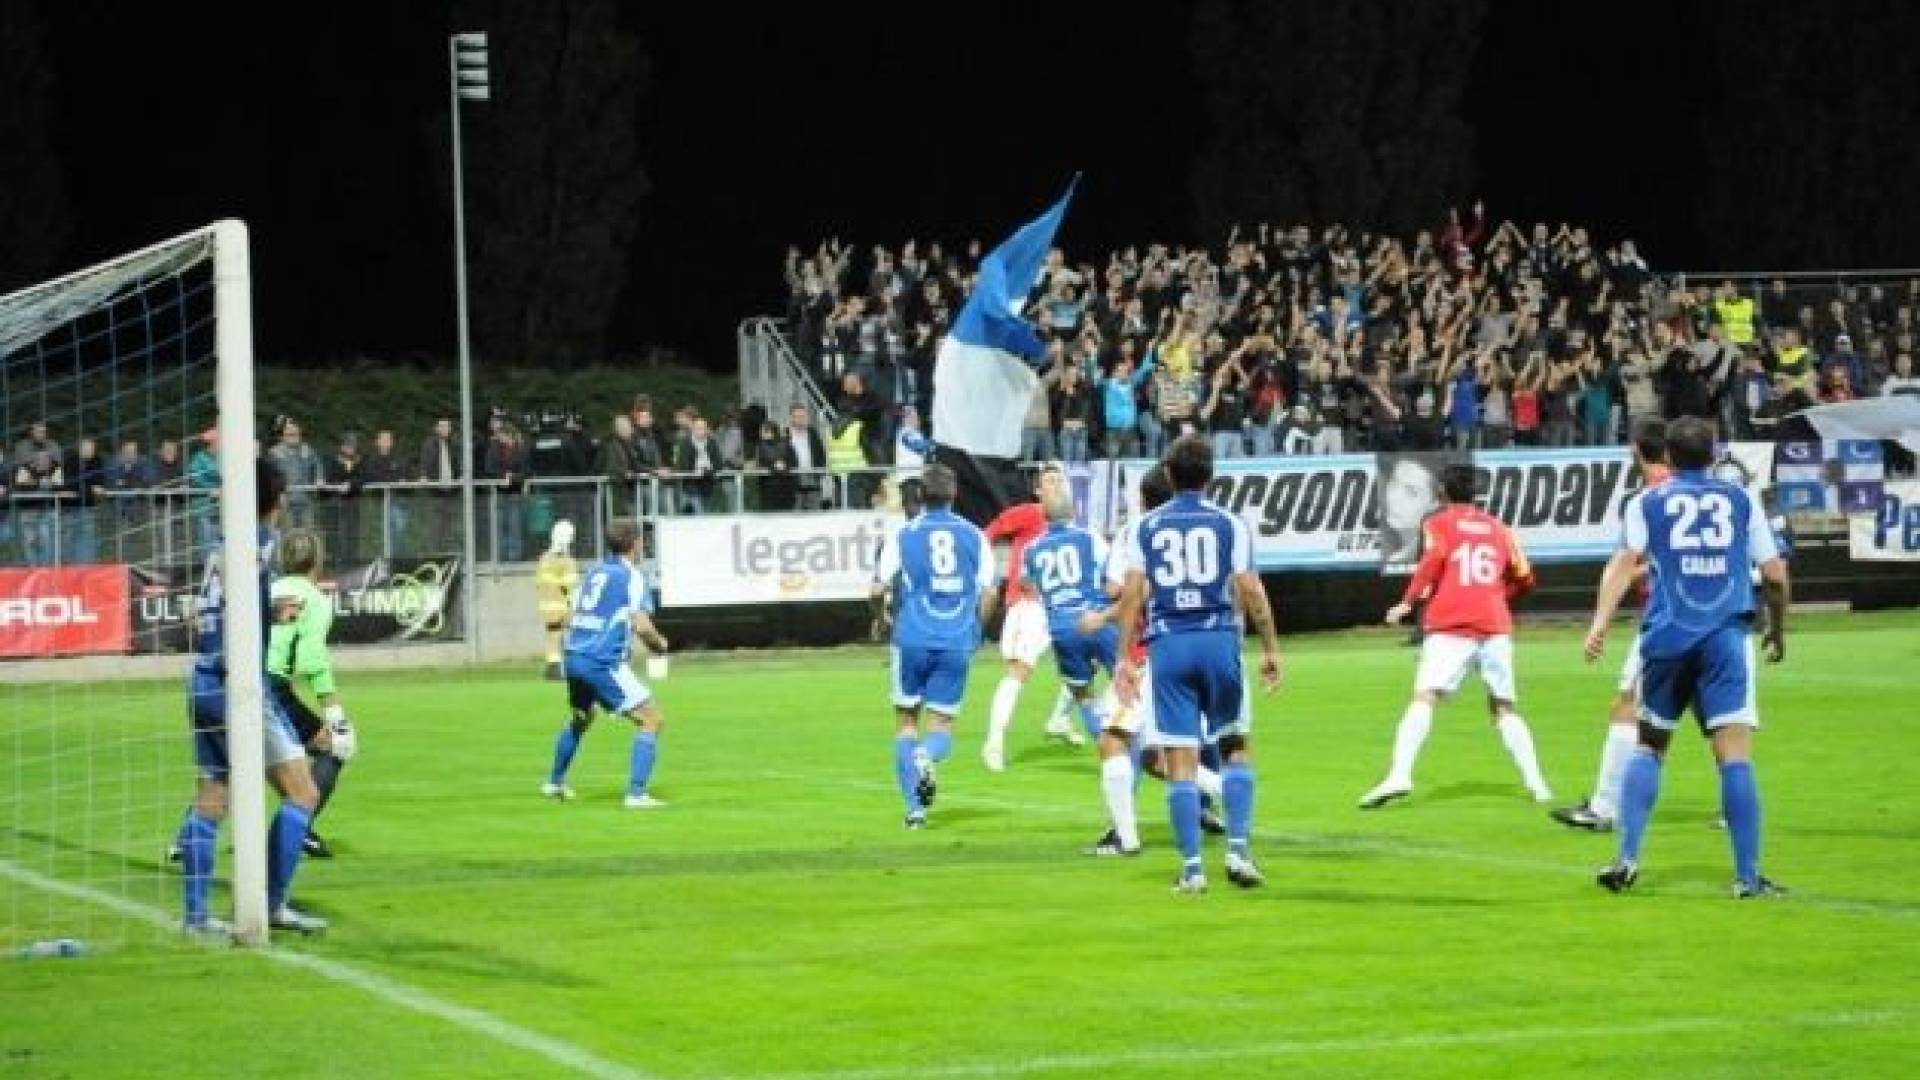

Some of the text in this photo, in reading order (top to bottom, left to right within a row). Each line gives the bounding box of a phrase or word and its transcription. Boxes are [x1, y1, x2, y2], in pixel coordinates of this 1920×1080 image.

[1664, 493, 1732, 549] 23
[930, 530, 956, 574] 8
[1034, 546, 1080, 591] 20
[1152, 528, 1218, 586] 30
[1451, 541, 1498, 586] 16
